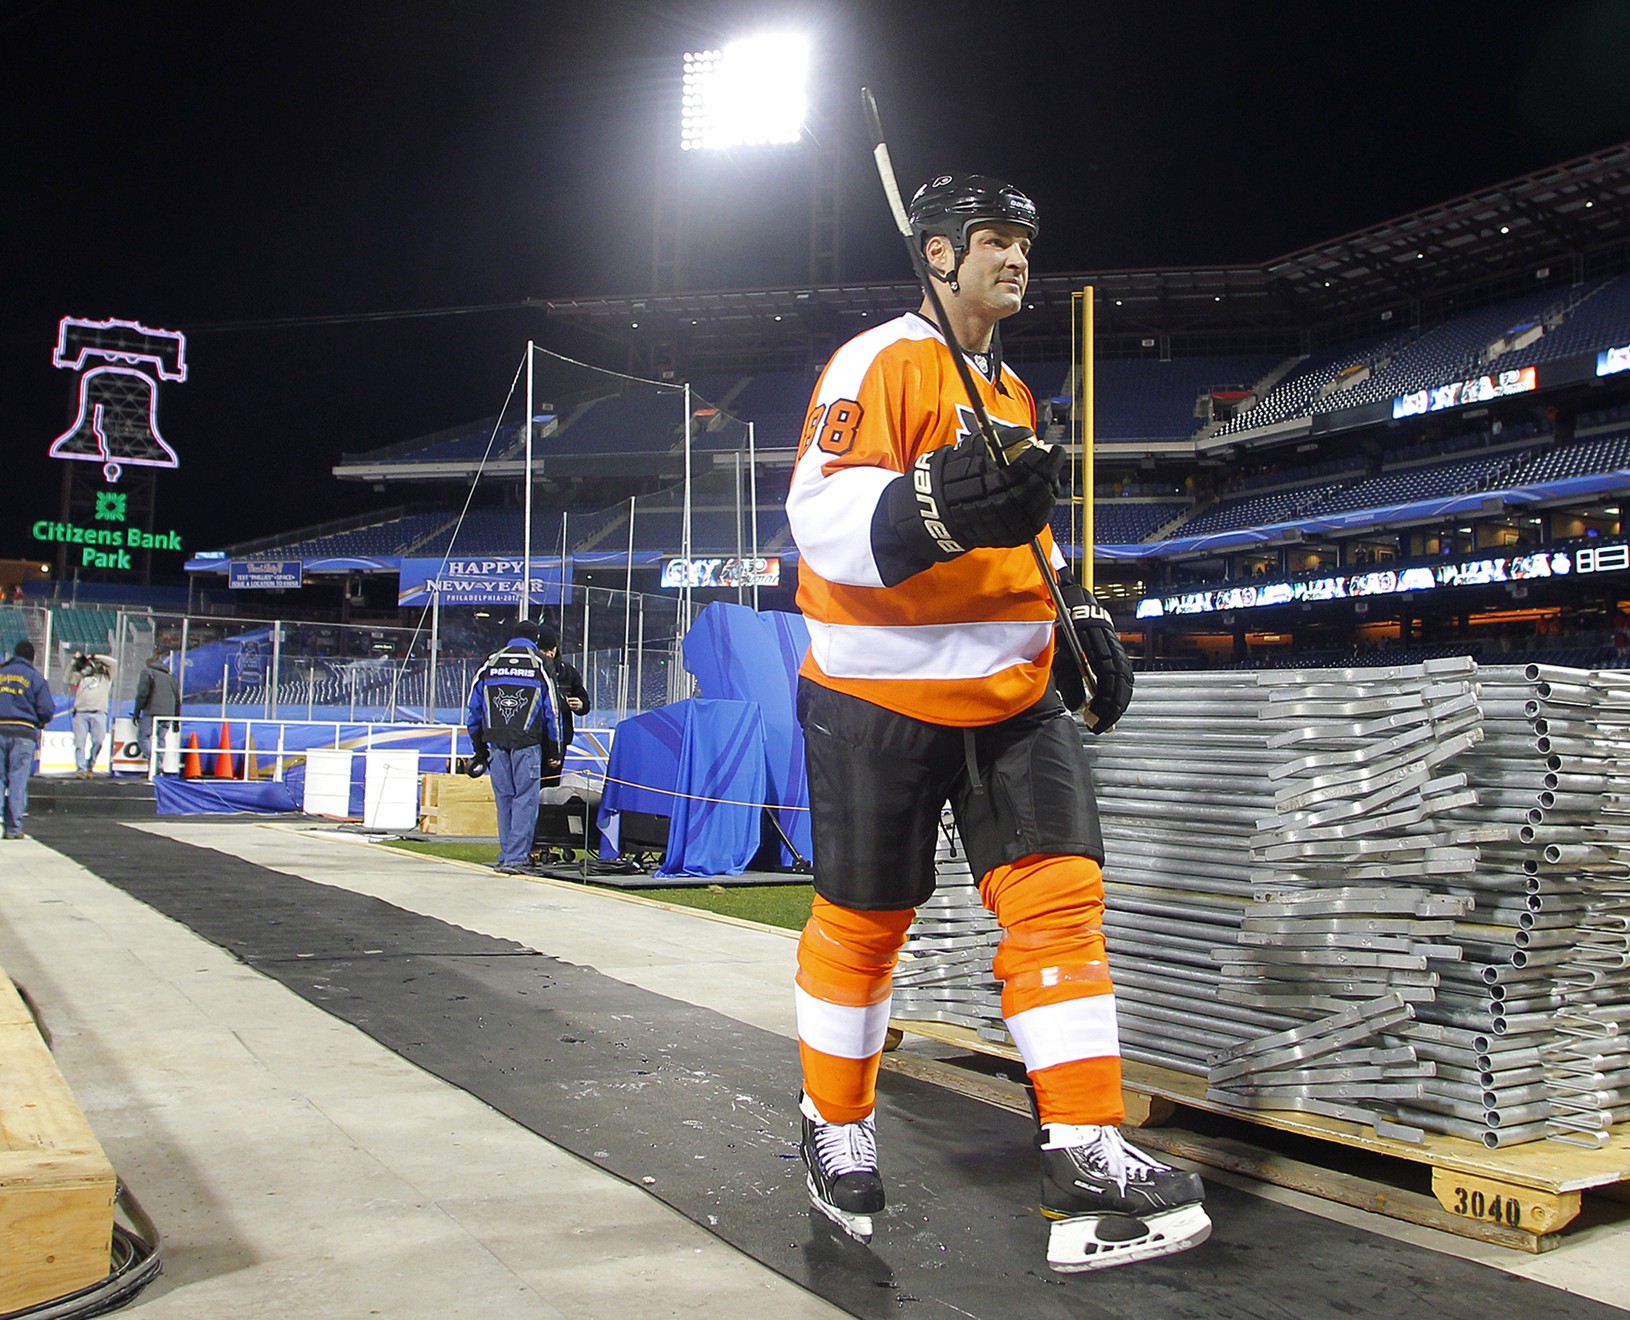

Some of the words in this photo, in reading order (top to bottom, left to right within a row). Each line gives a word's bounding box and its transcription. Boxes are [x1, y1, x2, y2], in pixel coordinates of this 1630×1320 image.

[32, 520, 123, 546] Citizens
[126, 527, 183, 550] Bank
[81, 547, 132, 570] Park
[449, 561, 524, 574] HAPPY
[426, 579, 475, 592] NEW
[482, 578, 545, 593] YEAR
[489, 667, 536, 678] POLARIS
[1453, 1186, 1521, 1228] 3040
